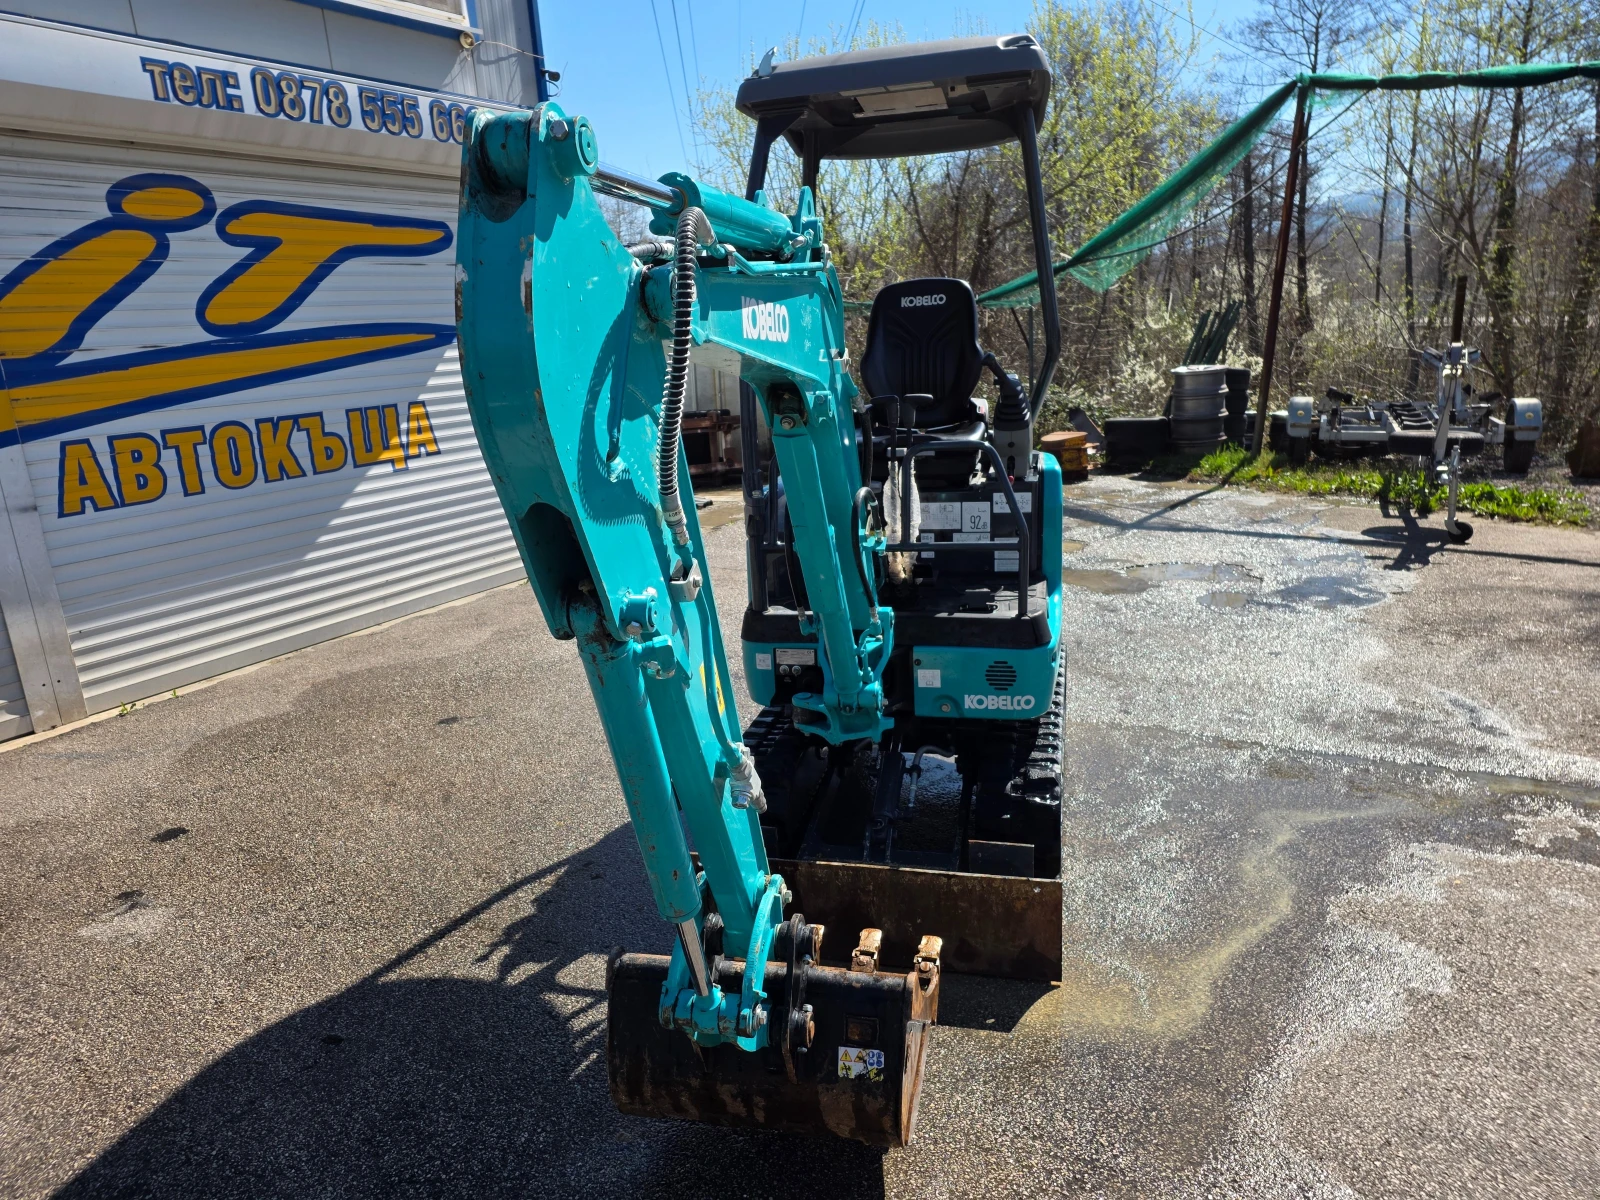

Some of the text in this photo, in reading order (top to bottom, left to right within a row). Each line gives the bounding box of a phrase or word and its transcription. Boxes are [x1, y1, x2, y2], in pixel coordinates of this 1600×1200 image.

[141, 57, 474, 145] тел: 0878 555 66
[741, 296, 789, 343] KOBELCO
[901, 294, 946, 307] KOBELCO
[57, 401, 442, 518] АВТОКЪЩА
[963, 694, 1035, 710] KOBELCO
